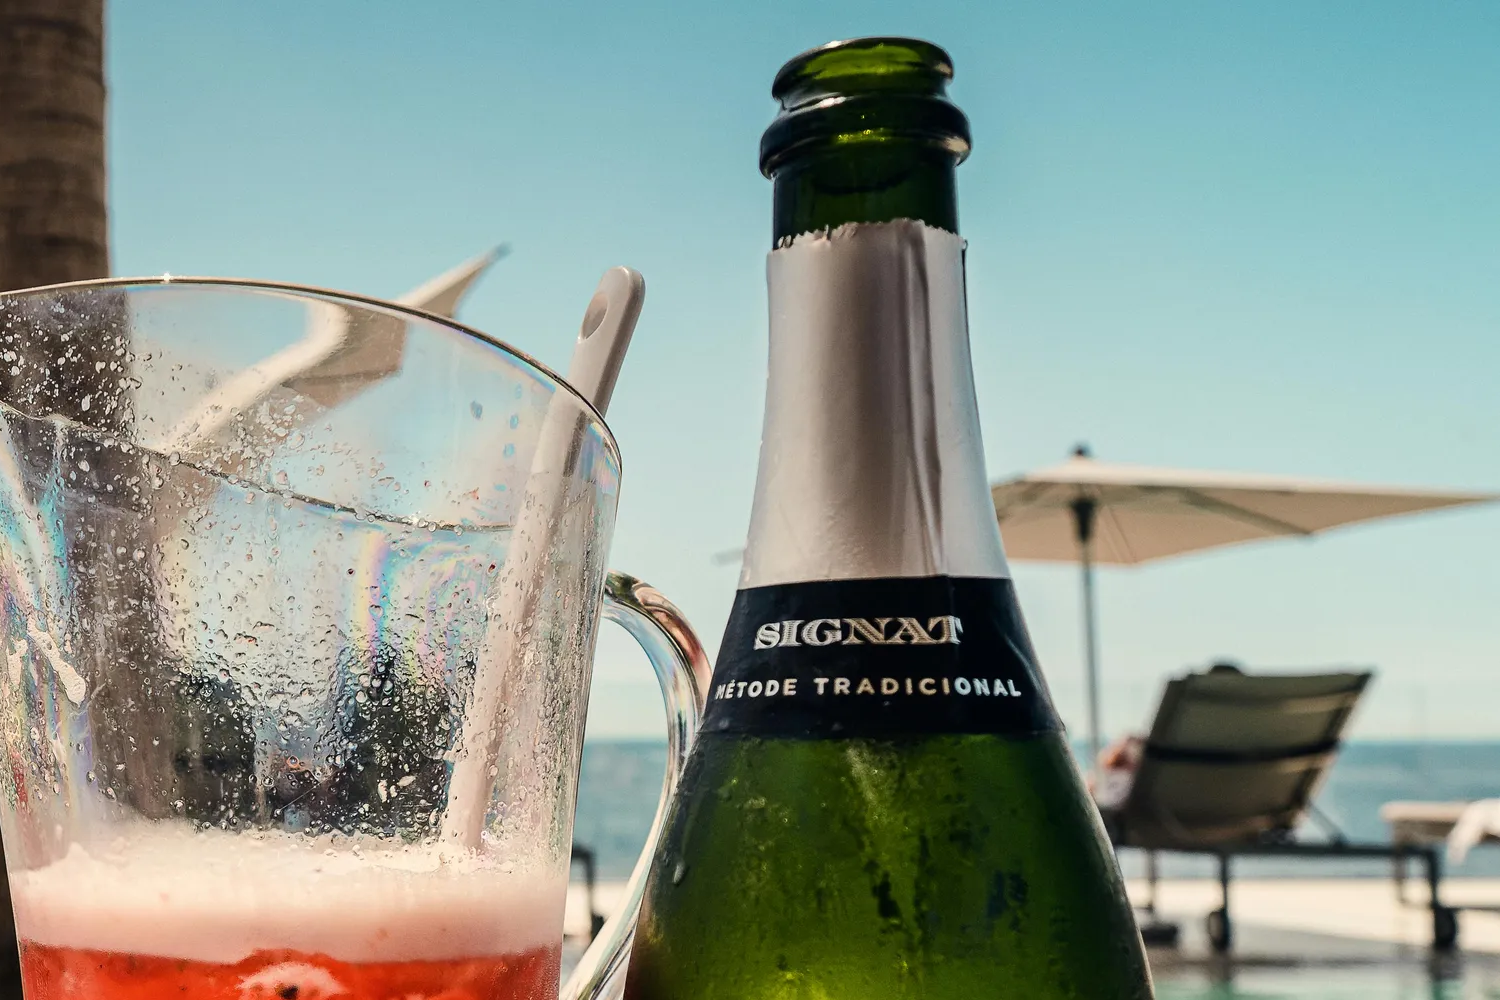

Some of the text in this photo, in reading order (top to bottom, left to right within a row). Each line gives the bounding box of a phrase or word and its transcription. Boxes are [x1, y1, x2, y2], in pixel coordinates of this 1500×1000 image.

[753, 615, 963, 650] SIGNAT
[714, 676, 1022, 700] MÉTODE TRADICIONAL
